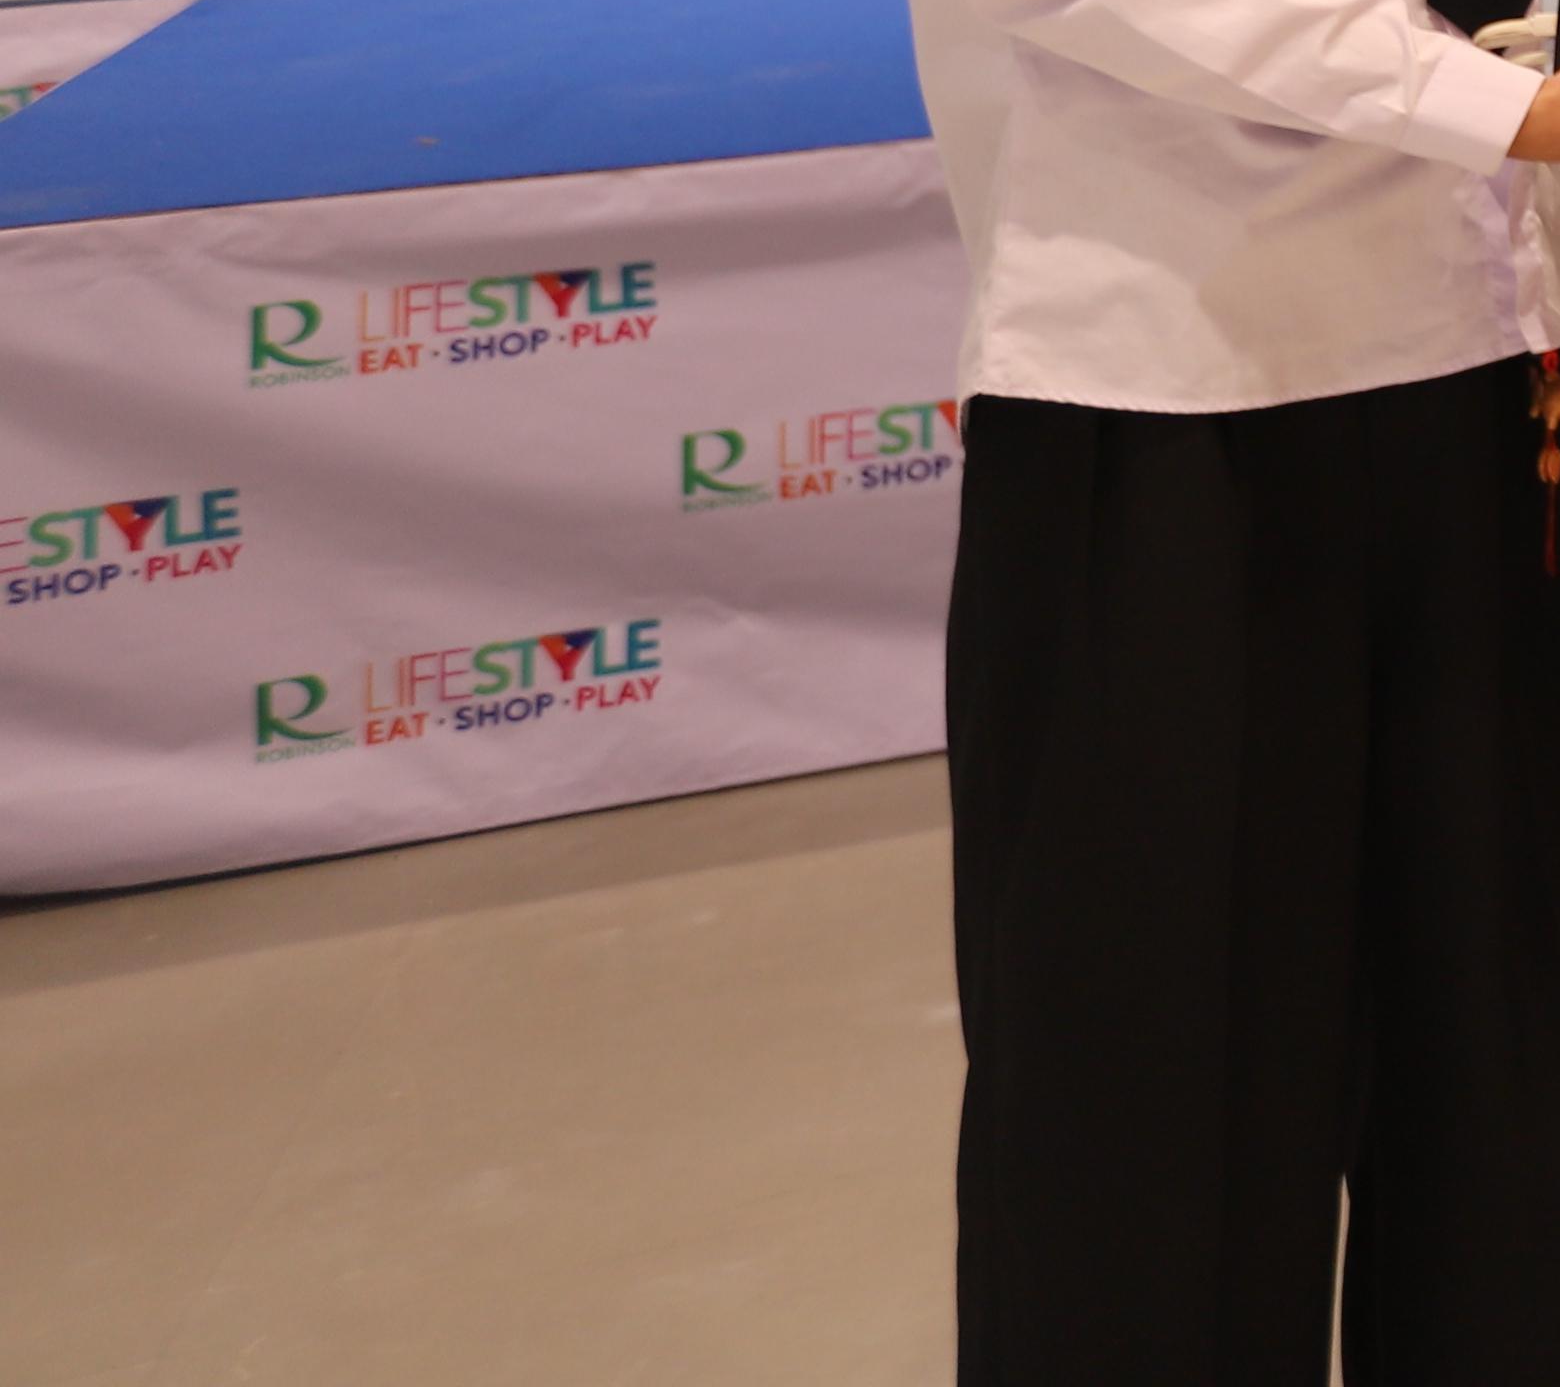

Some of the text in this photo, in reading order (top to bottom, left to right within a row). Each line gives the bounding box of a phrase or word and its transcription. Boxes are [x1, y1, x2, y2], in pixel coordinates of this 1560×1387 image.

[248, 299, 345, 372] R
[357, 261, 657, 344] LIFESTYLE
[358, 315, 658, 376] EAT SHOP PLAY
[776, 399, 961, 470] LIFEST
[779, 455, 953, 500] EAT SHOP
[0, 488, 242, 574] ESTYLE
[7, 543, 244, 605] SHOP PLAY
[362, 617, 662, 714] LIFESTYLE
[255, 673, 353, 746] R
[364, 676, 662, 746] EAT SHOP PLAY
